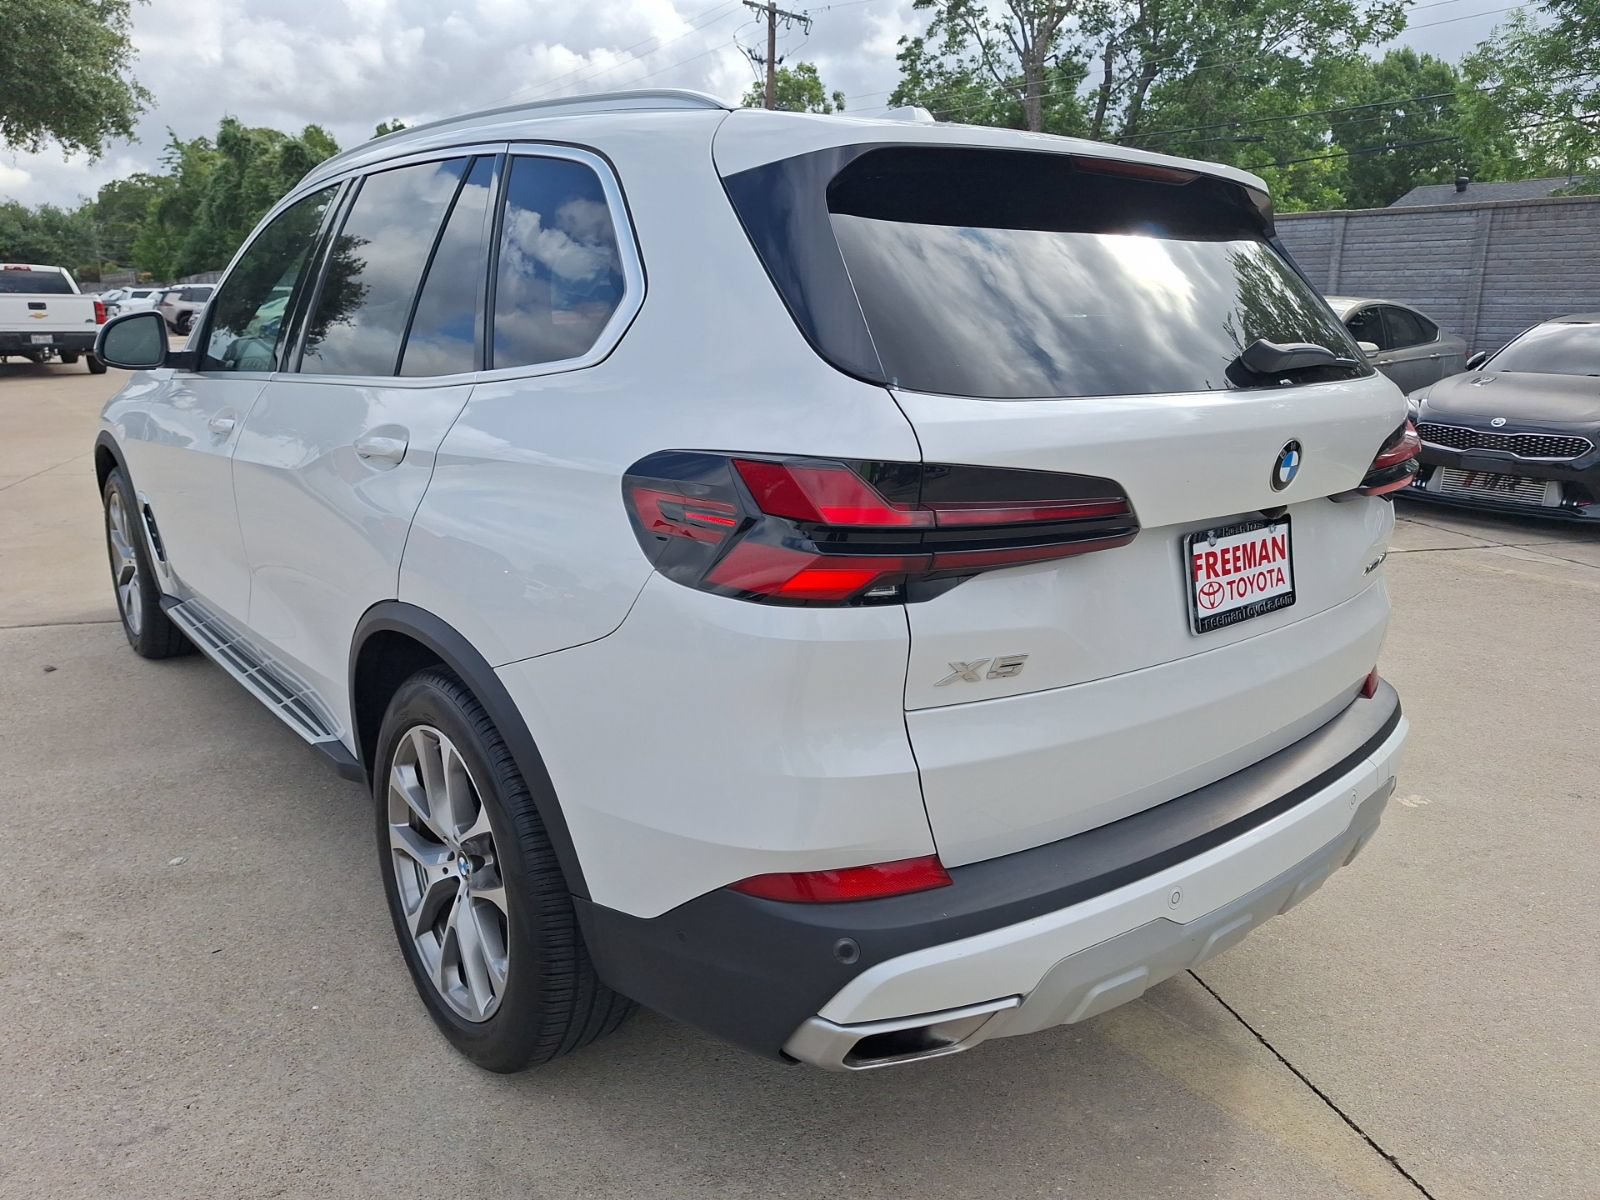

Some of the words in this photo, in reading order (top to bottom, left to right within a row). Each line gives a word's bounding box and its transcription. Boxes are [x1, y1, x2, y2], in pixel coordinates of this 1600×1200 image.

[1191, 534, 1286, 582] FREEMAN
[1226, 567, 1286, 600] TOYOTA
[932, 653, 1029, 687] X5
